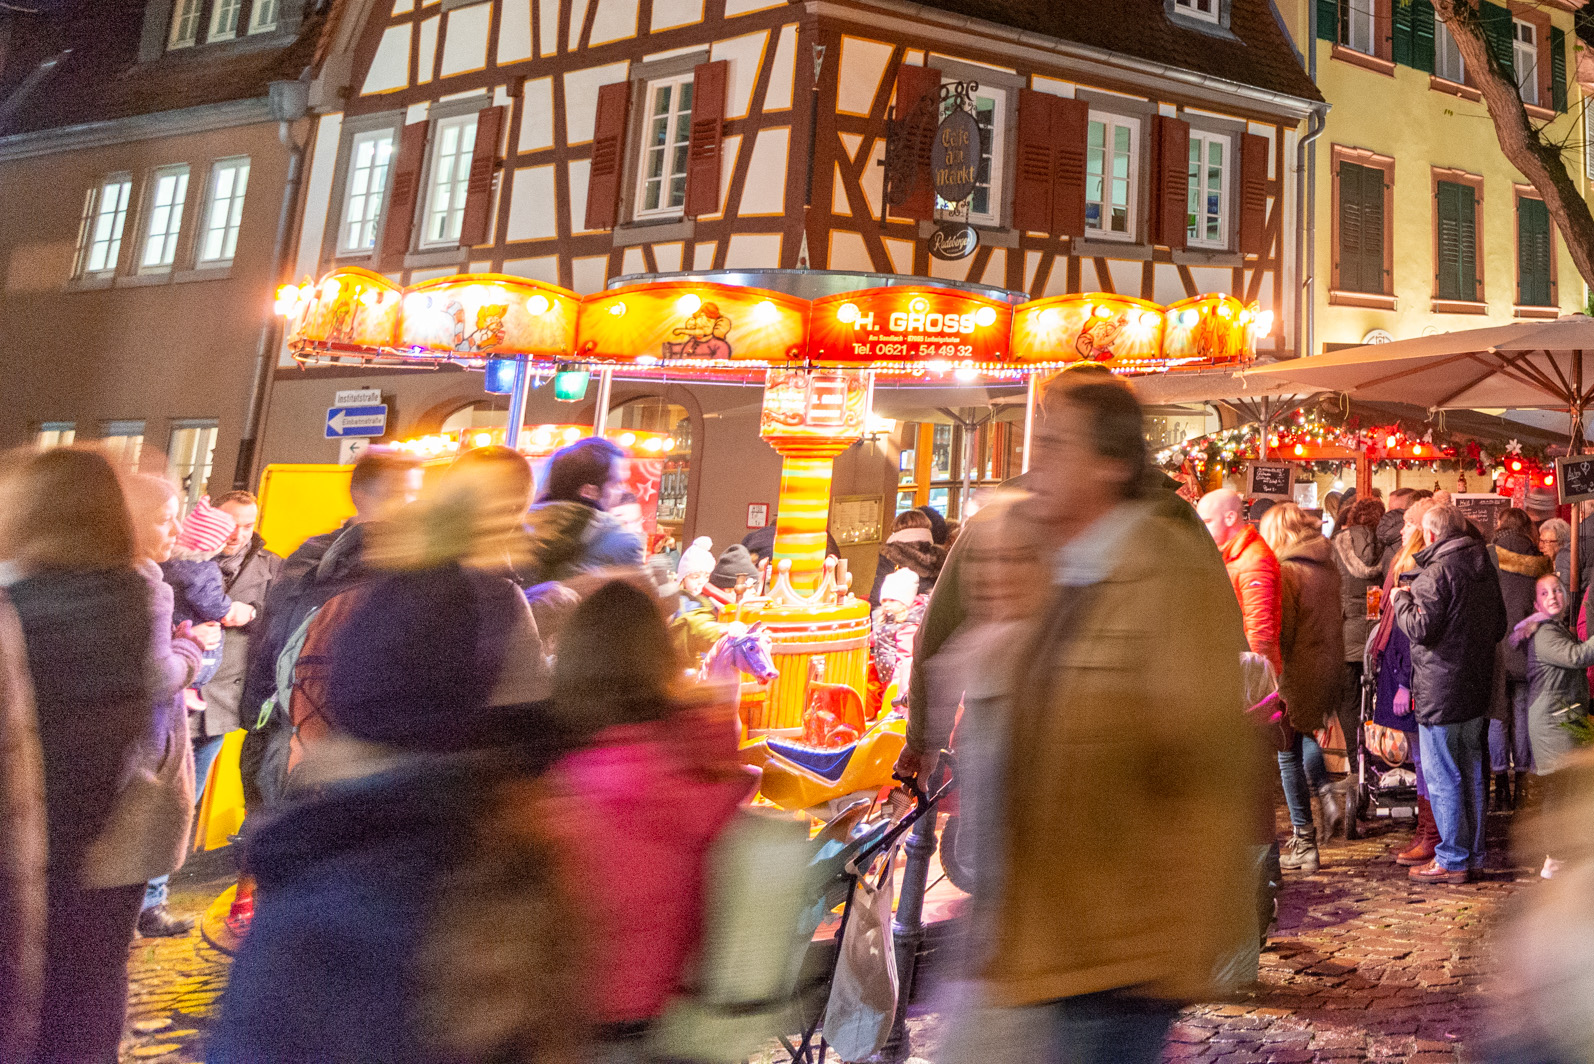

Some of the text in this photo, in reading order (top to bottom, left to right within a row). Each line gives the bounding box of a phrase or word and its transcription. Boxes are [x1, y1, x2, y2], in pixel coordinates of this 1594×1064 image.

[936, 166, 975, 186] Markt
[854, 311, 976, 334] H. GROSS
[852, 343, 973, 357] Tel. 0621 54 49 32
[337, 392, 379, 404] Institutstraße
